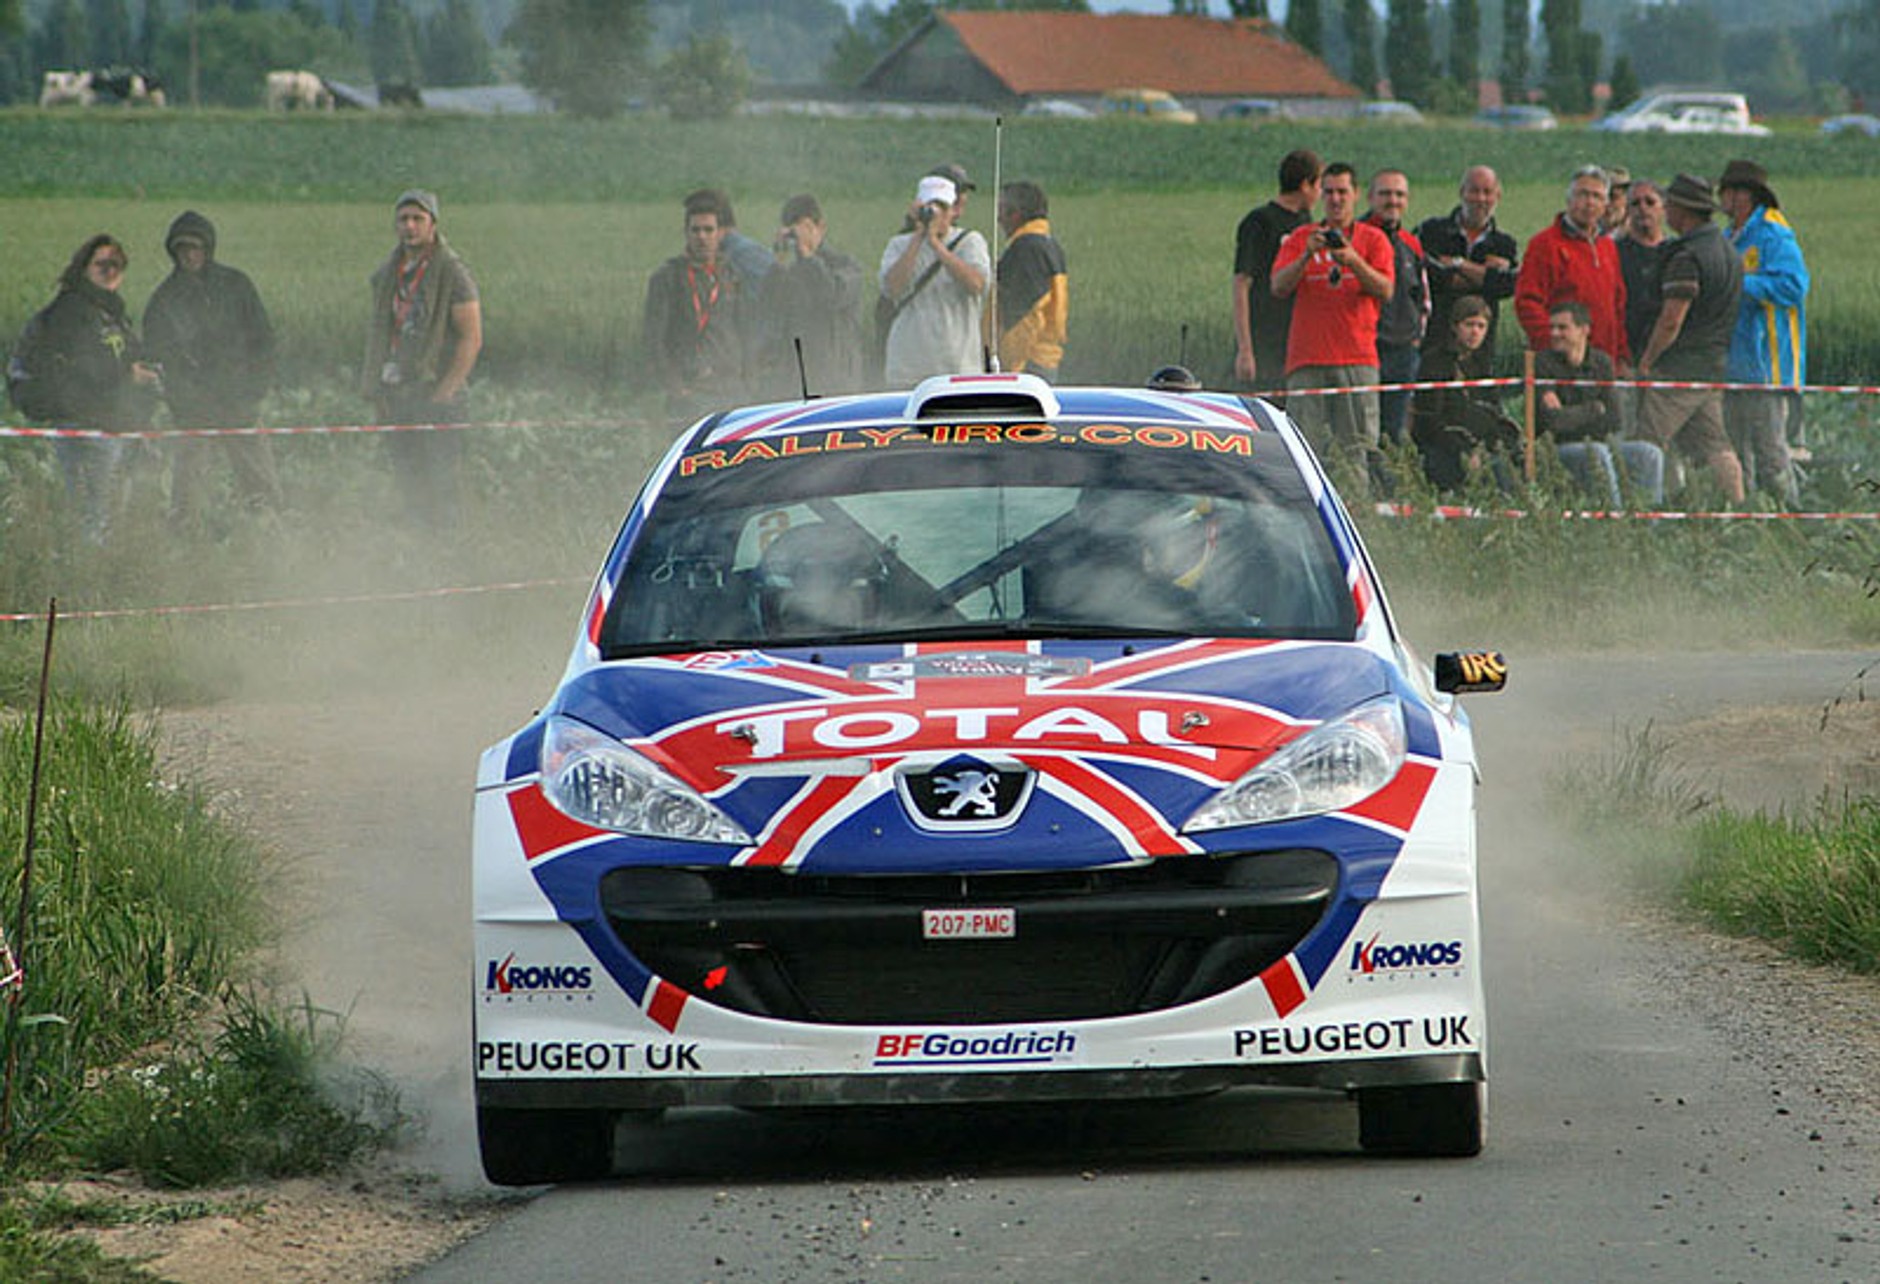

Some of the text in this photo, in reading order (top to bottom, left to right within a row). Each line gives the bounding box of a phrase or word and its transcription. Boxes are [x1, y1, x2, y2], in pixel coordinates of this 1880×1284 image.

[680, 424, 1252, 476] RALLY-IRC.COM
[715, 706, 1217, 760] TOTAL
[929, 914, 1010, 935] 207-PMC
[486, 951, 592, 993] KRONOS
[1350, 931, 1462, 973] KRONOS
[478, 1041, 703, 1072] PEUGEOT UK
[875, 1030, 1076, 1057] BFGoodrich
[1235, 1015, 1472, 1057] PEUGEOT UK
